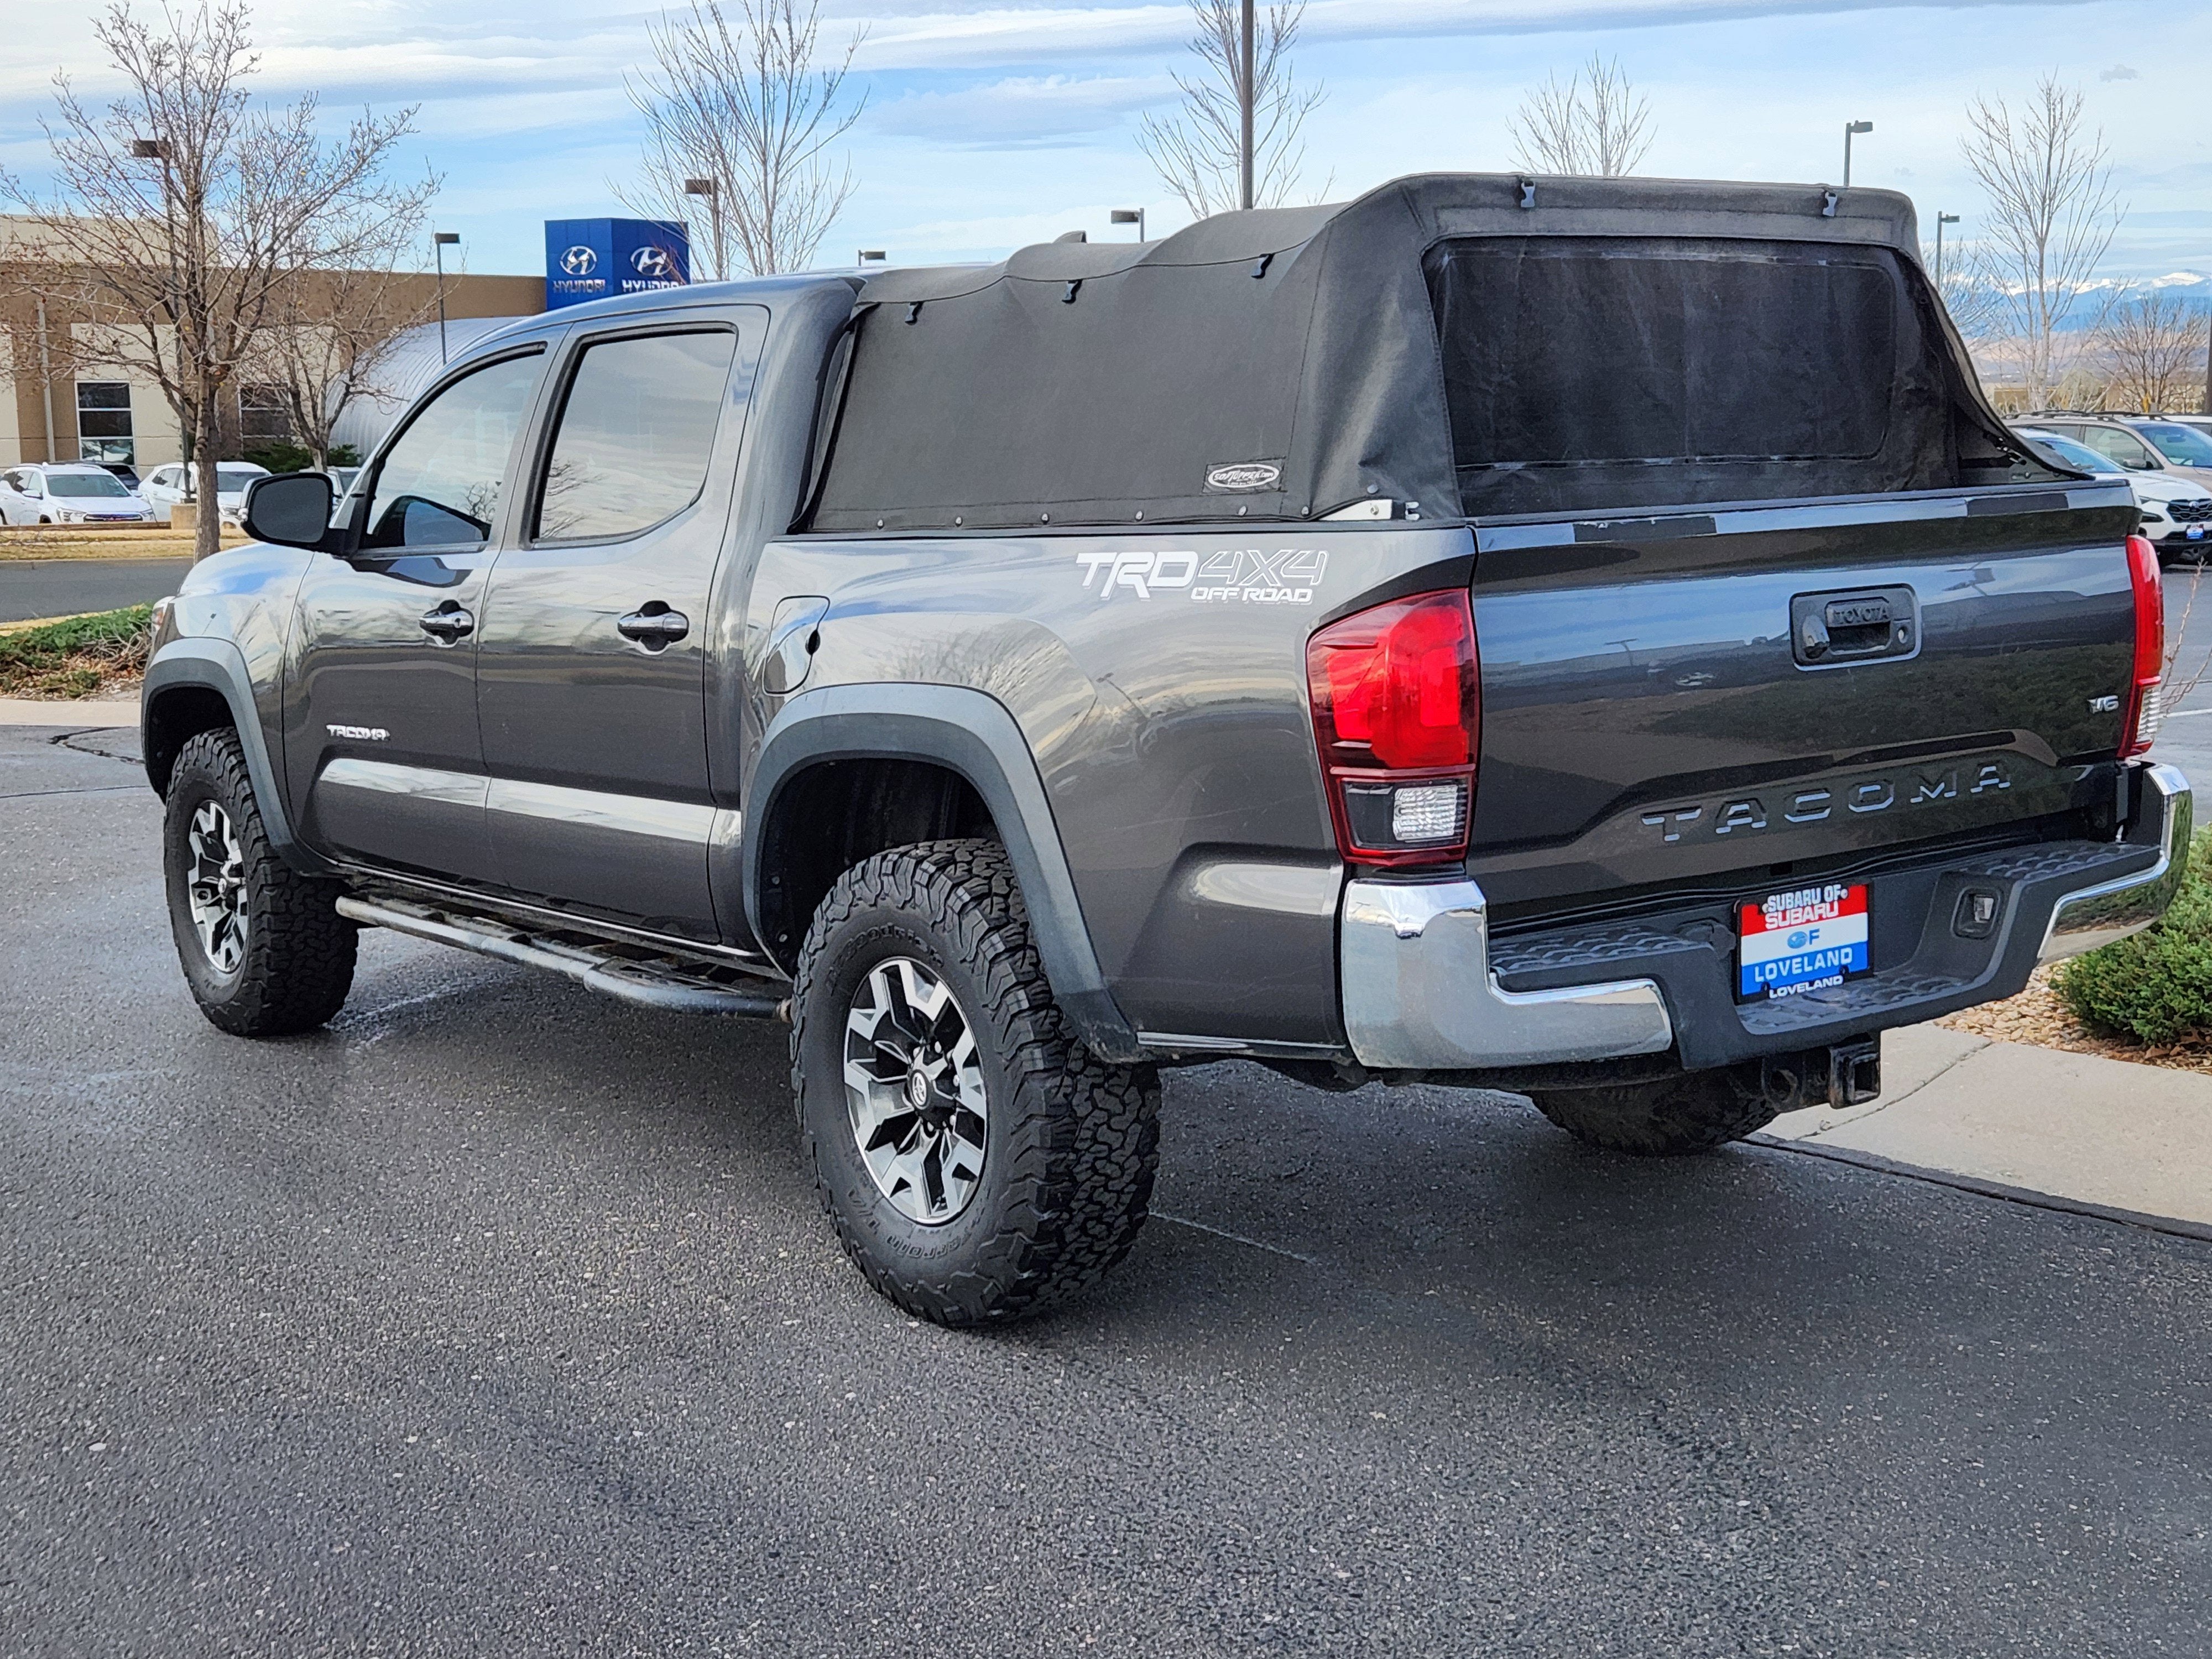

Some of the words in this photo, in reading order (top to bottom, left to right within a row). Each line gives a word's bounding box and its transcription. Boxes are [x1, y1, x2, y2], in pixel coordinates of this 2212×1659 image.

[552, 279, 606, 294] HYUNDAI
[622, 279, 685, 293] HYUND
[1076, 551, 1199, 599] TRD
[1191, 587, 1238, 601] OFF
[1241, 587, 1313, 603] ROAD
[1833, 606, 1888, 624] TOYOTA
[325, 724, 390, 741] TACOMA
[1640, 760, 2011, 842] TACOMA
[1767, 887, 1821, 912] SUBARU
[1824, 884, 1842, 904] OF
[1765, 900, 1839, 930] SUBARU
[1755, 947, 1853, 983] LOVELAND
[1769, 975, 1844, 999] LOVELAND
